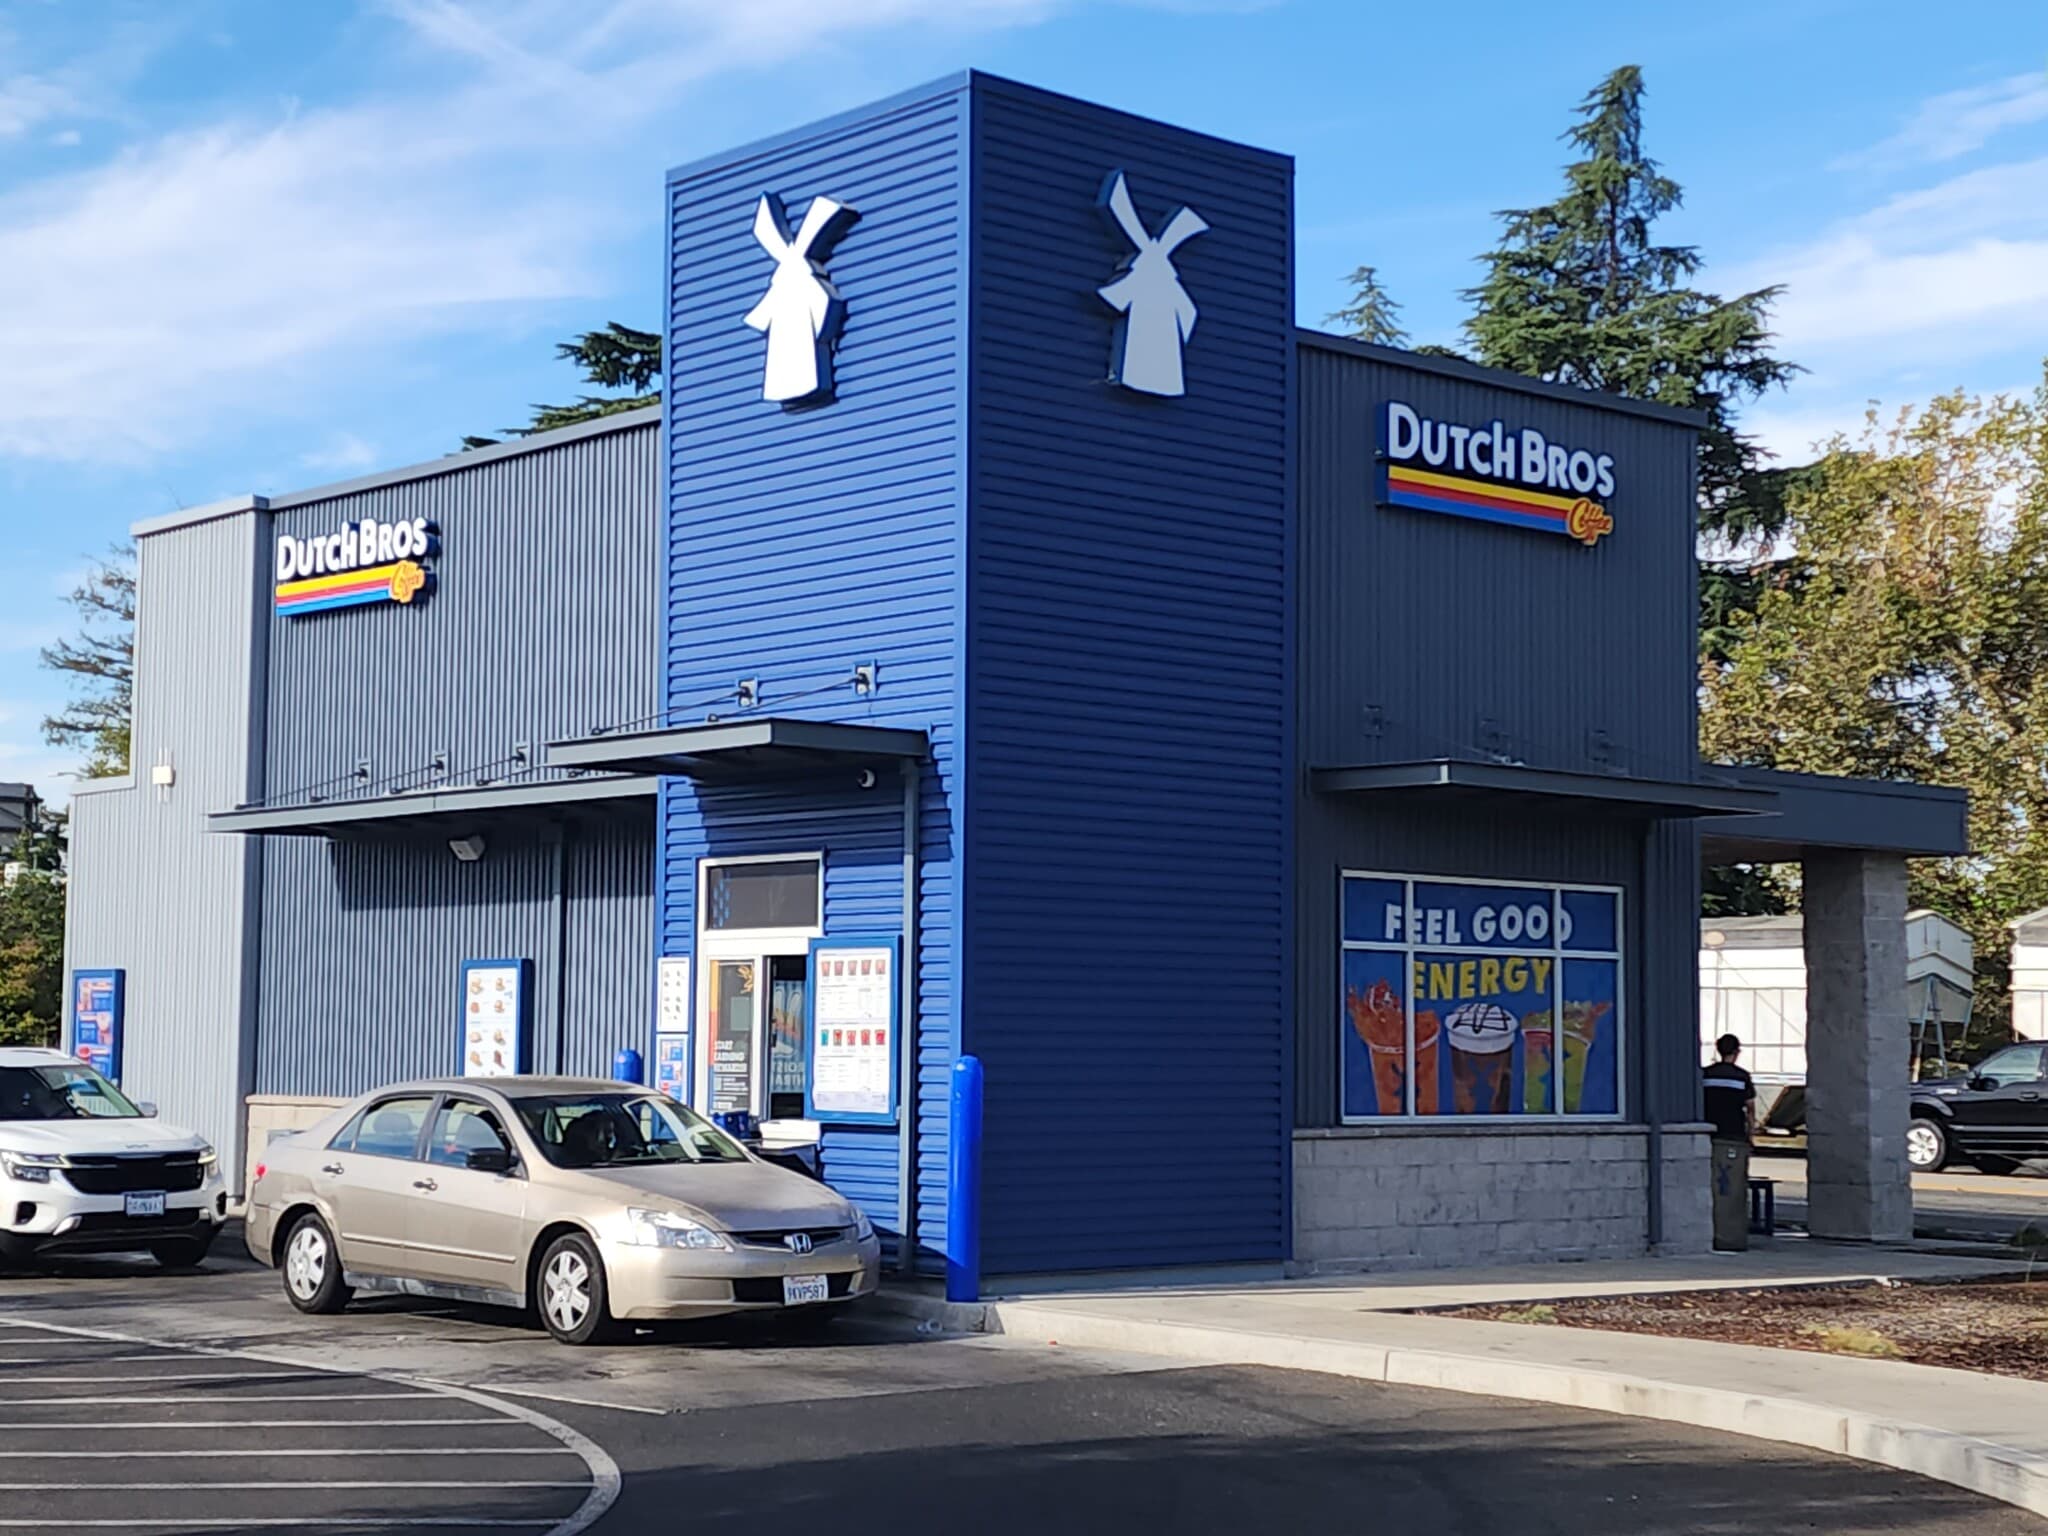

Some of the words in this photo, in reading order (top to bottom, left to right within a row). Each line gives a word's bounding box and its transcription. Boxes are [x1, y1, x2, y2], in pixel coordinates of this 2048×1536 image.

[1521, 428, 1615, 498] BROS
[359, 516, 429, 566] BROS
[1384, 902, 1462, 944] FEEL
[1472, 904, 1573, 943] GOOD
[1412, 956, 1551, 1000] ENERGY
